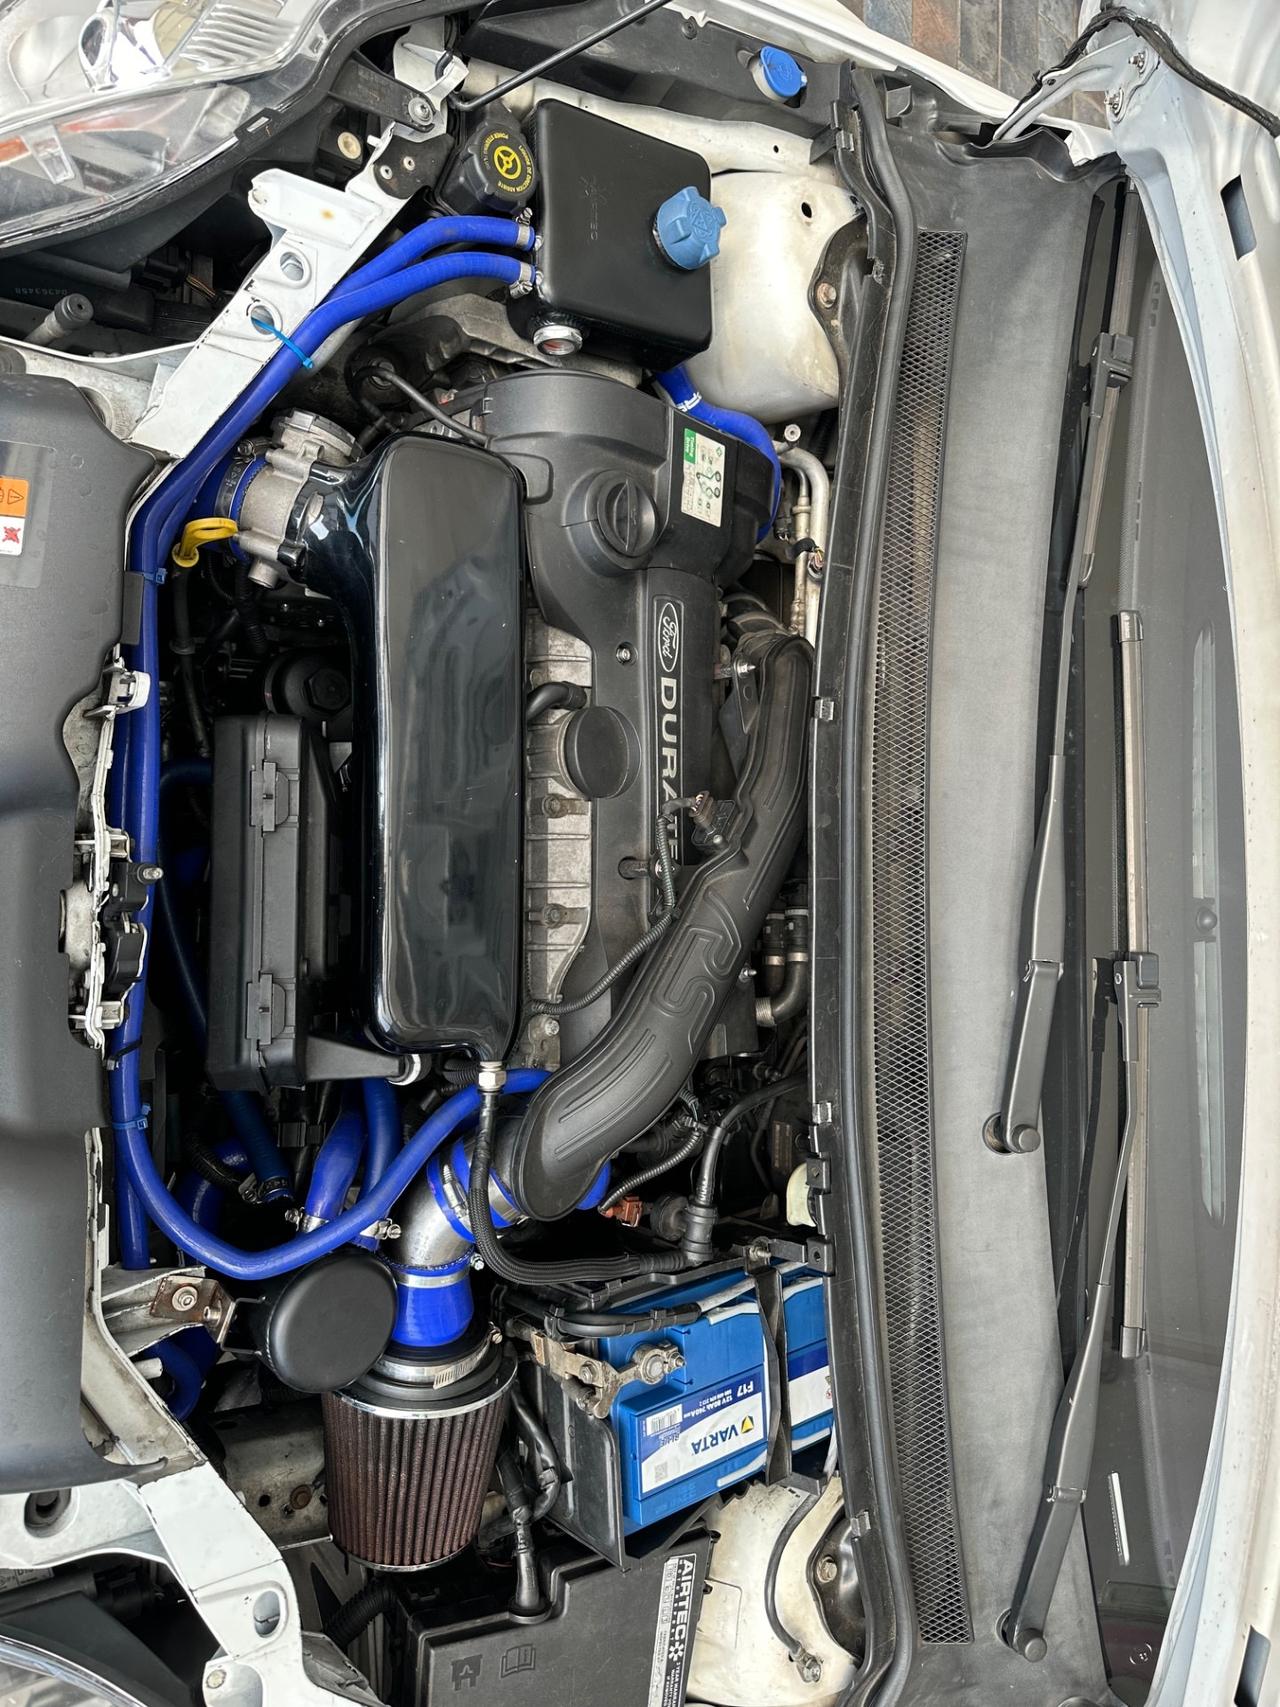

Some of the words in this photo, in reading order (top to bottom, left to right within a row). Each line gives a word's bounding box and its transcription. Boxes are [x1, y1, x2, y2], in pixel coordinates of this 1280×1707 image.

[737, 1380, 754, 1397] F17
[691, 1424, 739, 1455] VARTA
[675, 1559, 694, 1641] AIRTEC
